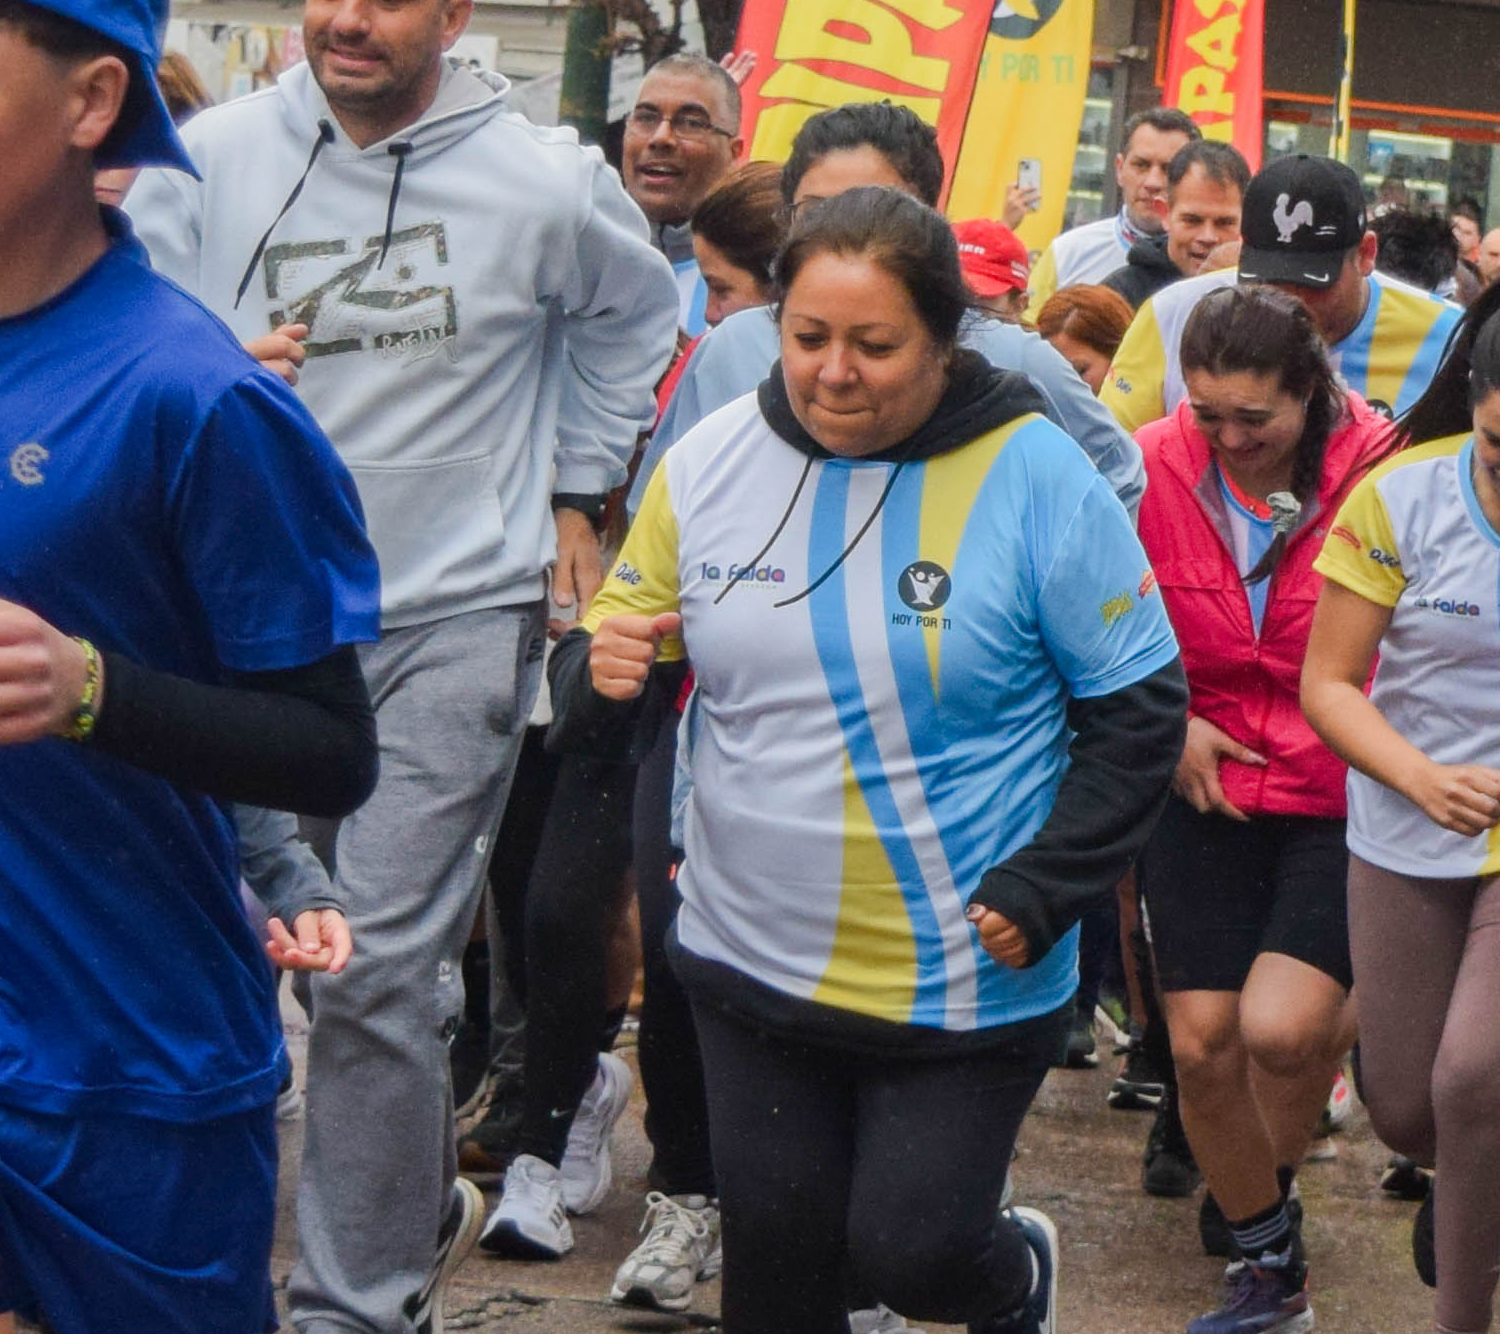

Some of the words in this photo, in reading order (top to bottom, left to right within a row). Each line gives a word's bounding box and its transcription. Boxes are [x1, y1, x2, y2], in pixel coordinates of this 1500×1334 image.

[615, 562, 642, 586] Dale
[701, 562, 721, 580] la
[728, 563, 785, 583] falda
[1433, 598, 1481, 617] falda
[892, 613, 912, 627] HOY
[916, 614, 938, 629] POR
[941, 617, 952, 630] TI
